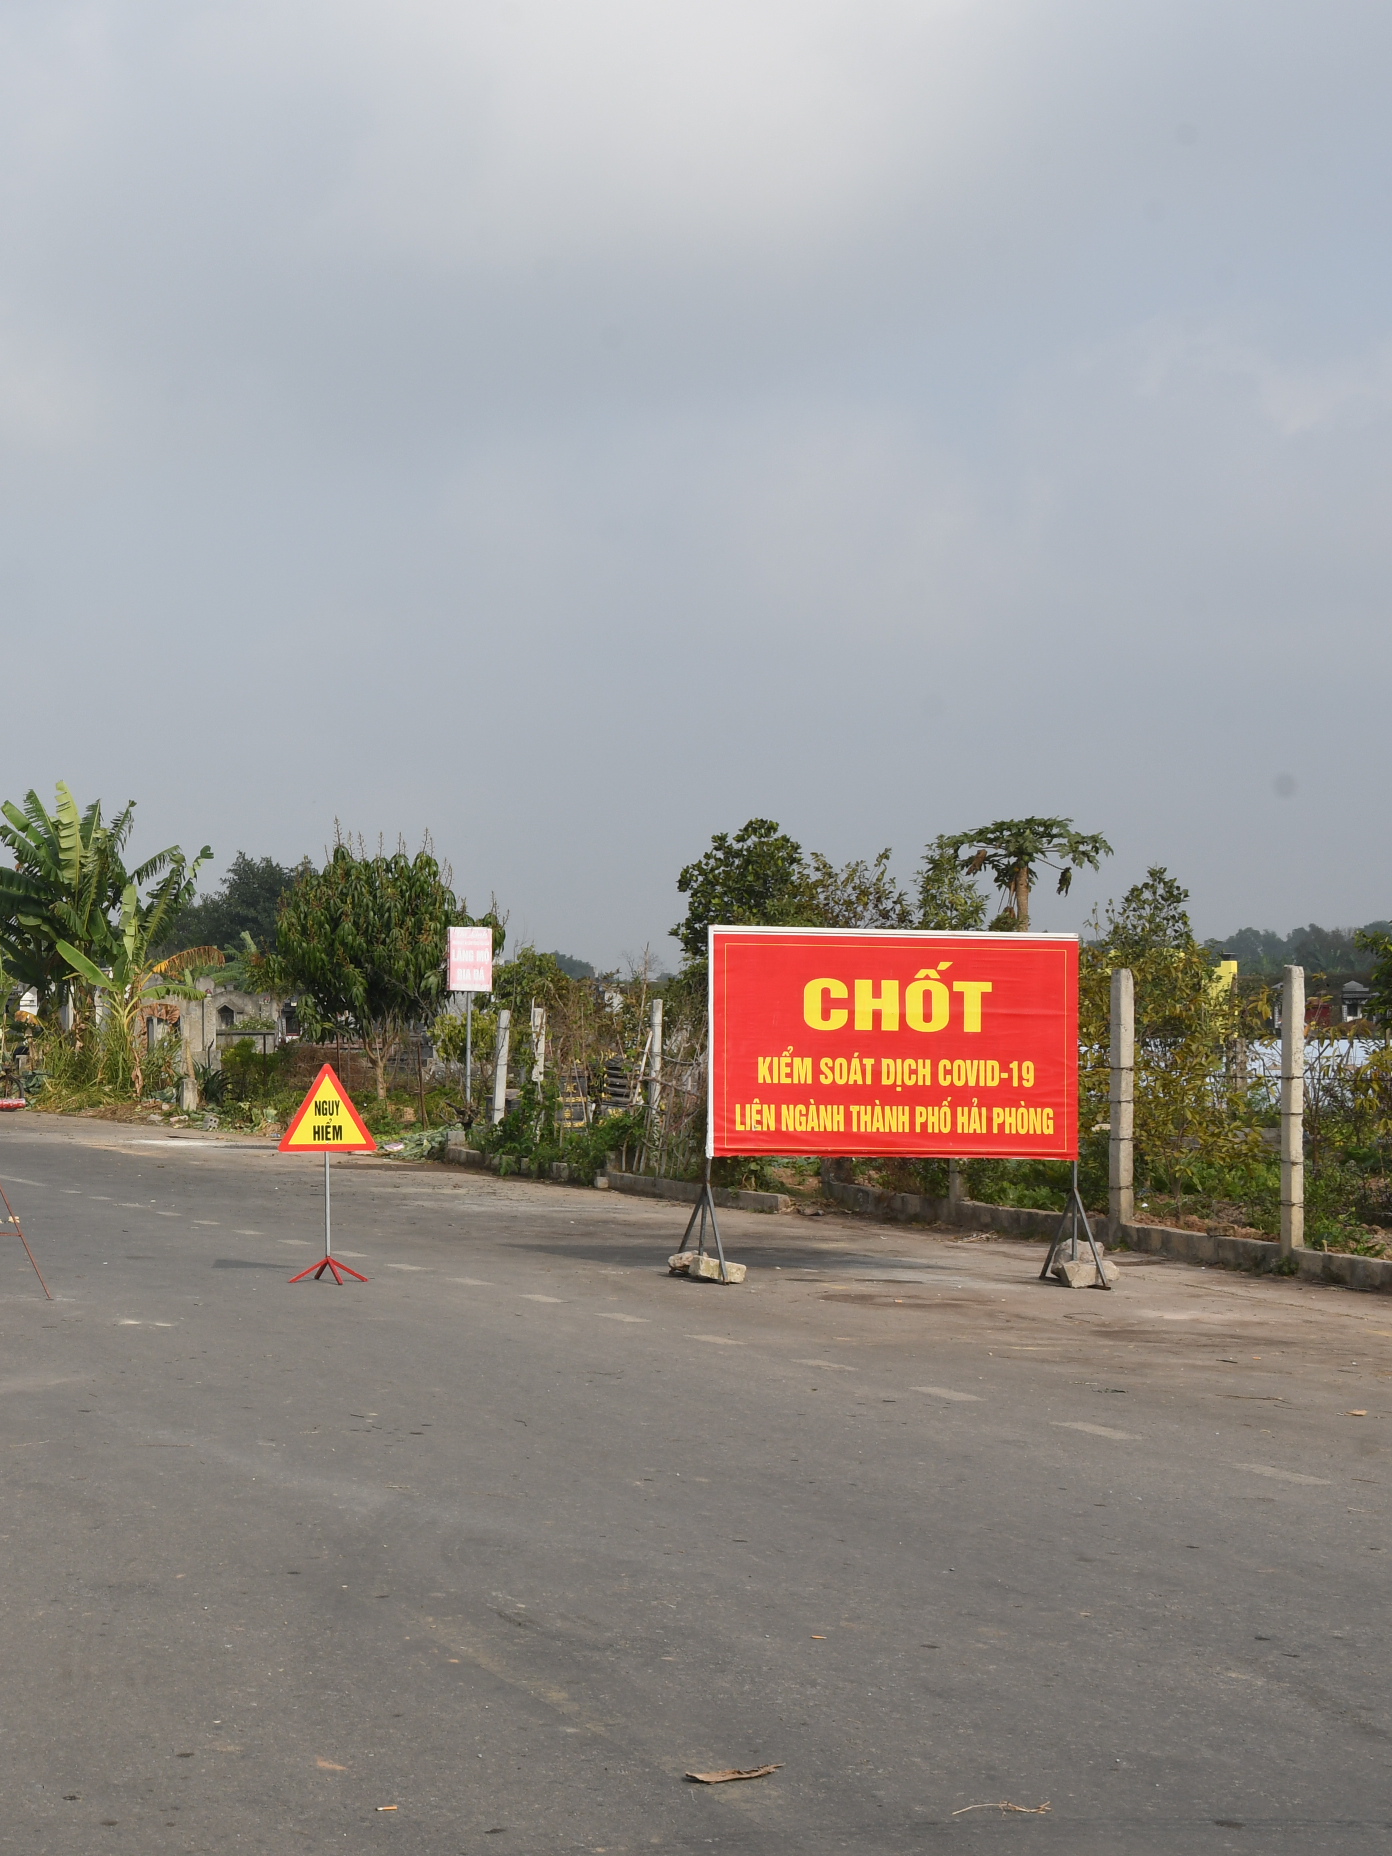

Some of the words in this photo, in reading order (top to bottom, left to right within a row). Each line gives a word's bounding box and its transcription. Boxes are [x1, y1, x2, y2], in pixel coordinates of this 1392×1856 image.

[803, 961, 993, 1033] CHỐT
[758, 1046, 813, 1084] KIỂM
[820, 1052, 875, 1085] SOÁT
[882, 1058, 932, 1092] DỊCH
[939, 1059, 1035, 1088] COVID-19
[314, 1100, 341, 1117] NGUY
[735, 1098, 776, 1132] LIÊN
[782, 1099, 845, 1132] NGÀNH
[850, 1100, 910, 1133] THÀNH
[916, 1096, 952, 1134] PHỐ
[957, 1097, 987, 1134] HẢI
[993, 1101, 1054, 1135] PHÒNG
[312, 1118, 343, 1141] HIỂM
